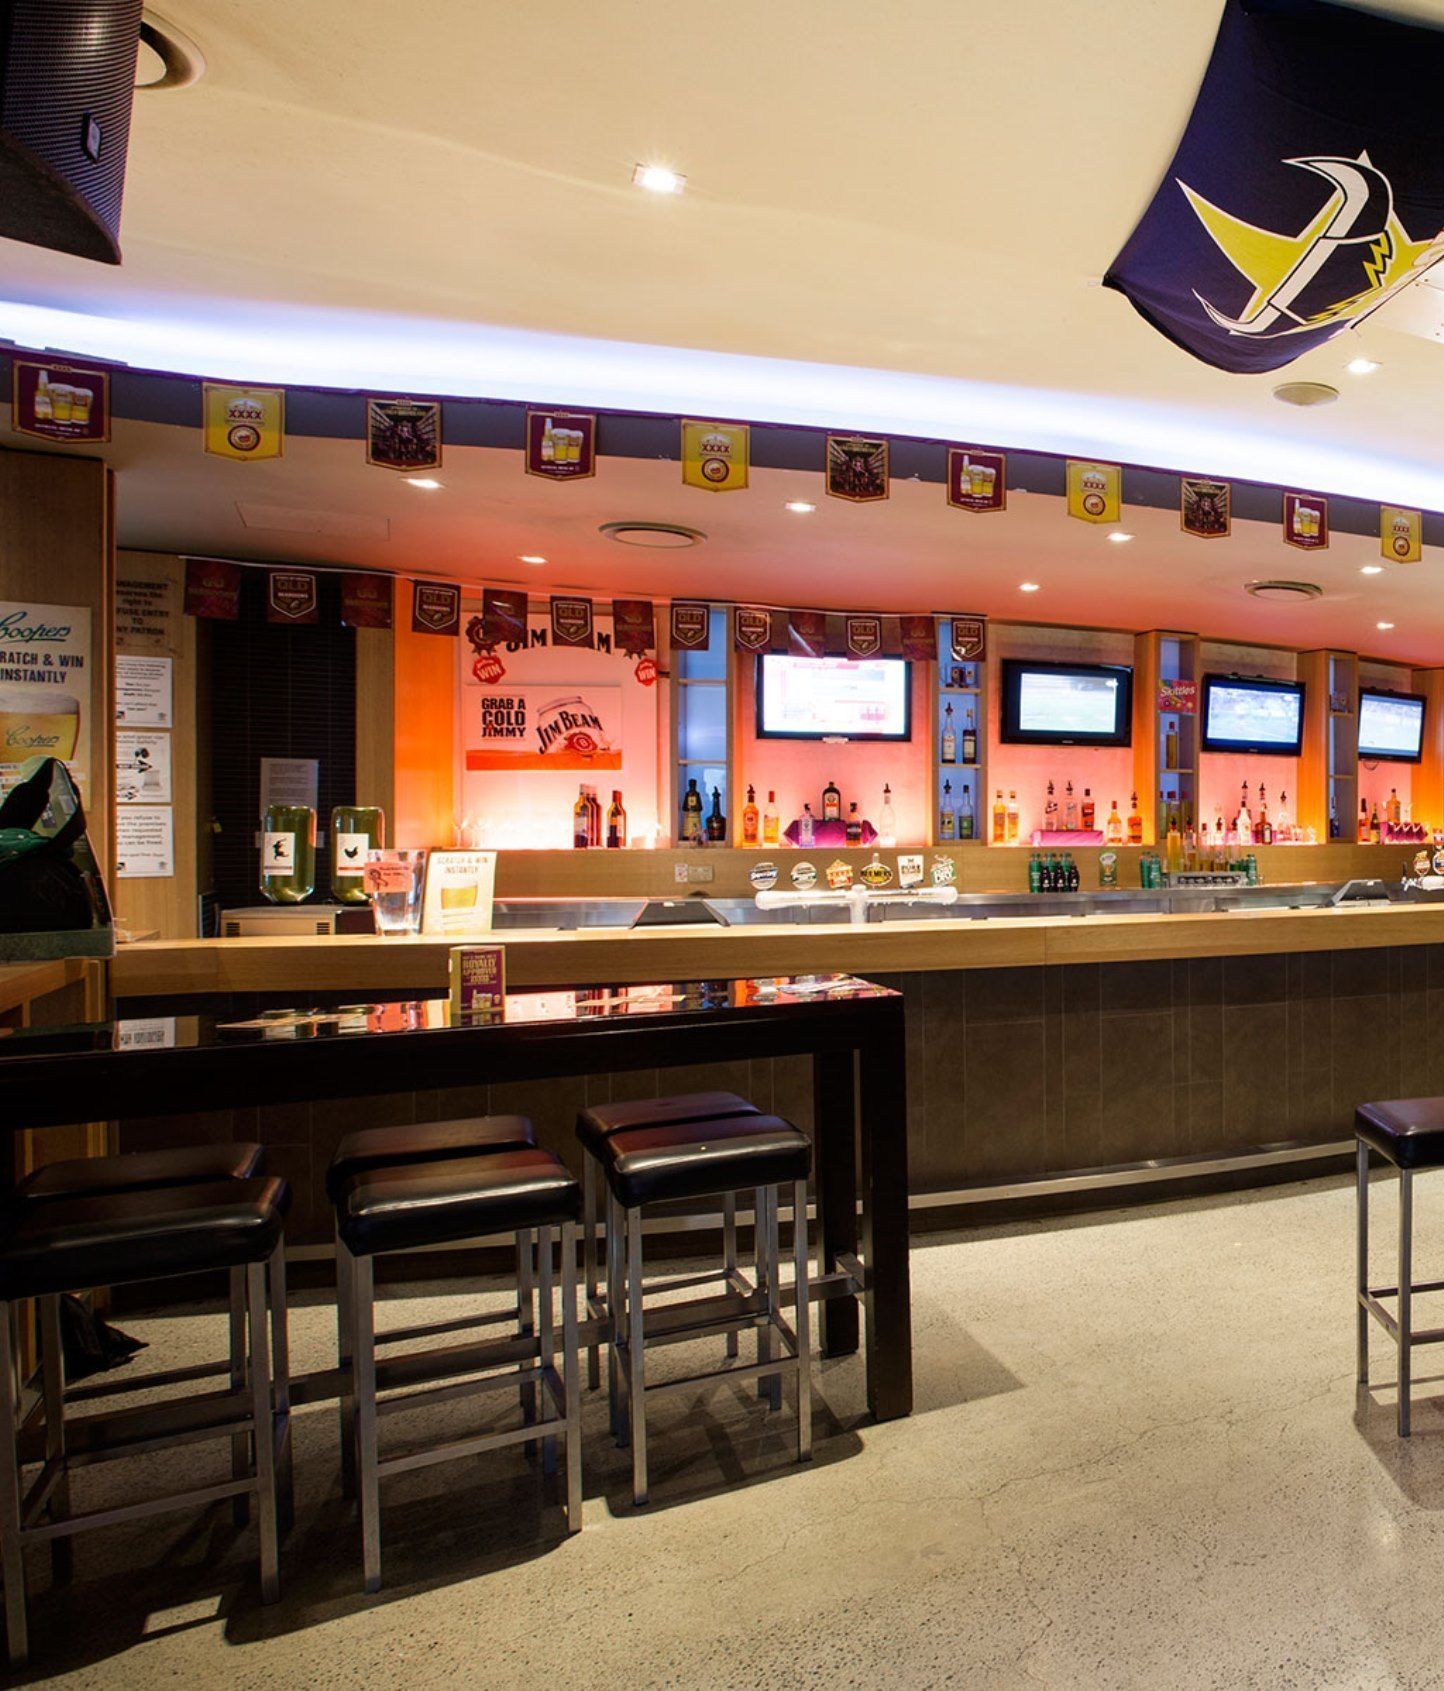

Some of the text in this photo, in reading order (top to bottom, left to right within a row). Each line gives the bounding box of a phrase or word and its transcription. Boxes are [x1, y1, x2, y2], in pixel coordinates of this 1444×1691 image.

[229, 409, 262, 420] XXXX
[701, 444, 730, 454] XXXX
[116, 607, 139, 616] FUSE
[0, 611, 71, 643] Coopers
[116, 626, 128, 634] NY
[0, 651, 84, 668] RATCH & WIN
[0, 668, 67, 684] INSTANTLY
[479, 664, 502, 680] WIN
[637, 666, 656, 681] WIN
[1160, 684, 1196, 698] Skittles
[481, 698, 526, 710] GRAB A
[481, 710, 526, 726] COLD
[6, 724, 60, 748] Coopers
[481, 727, 526, 738] JIMMY
[535, 710, 603, 755] JIM BEAM
